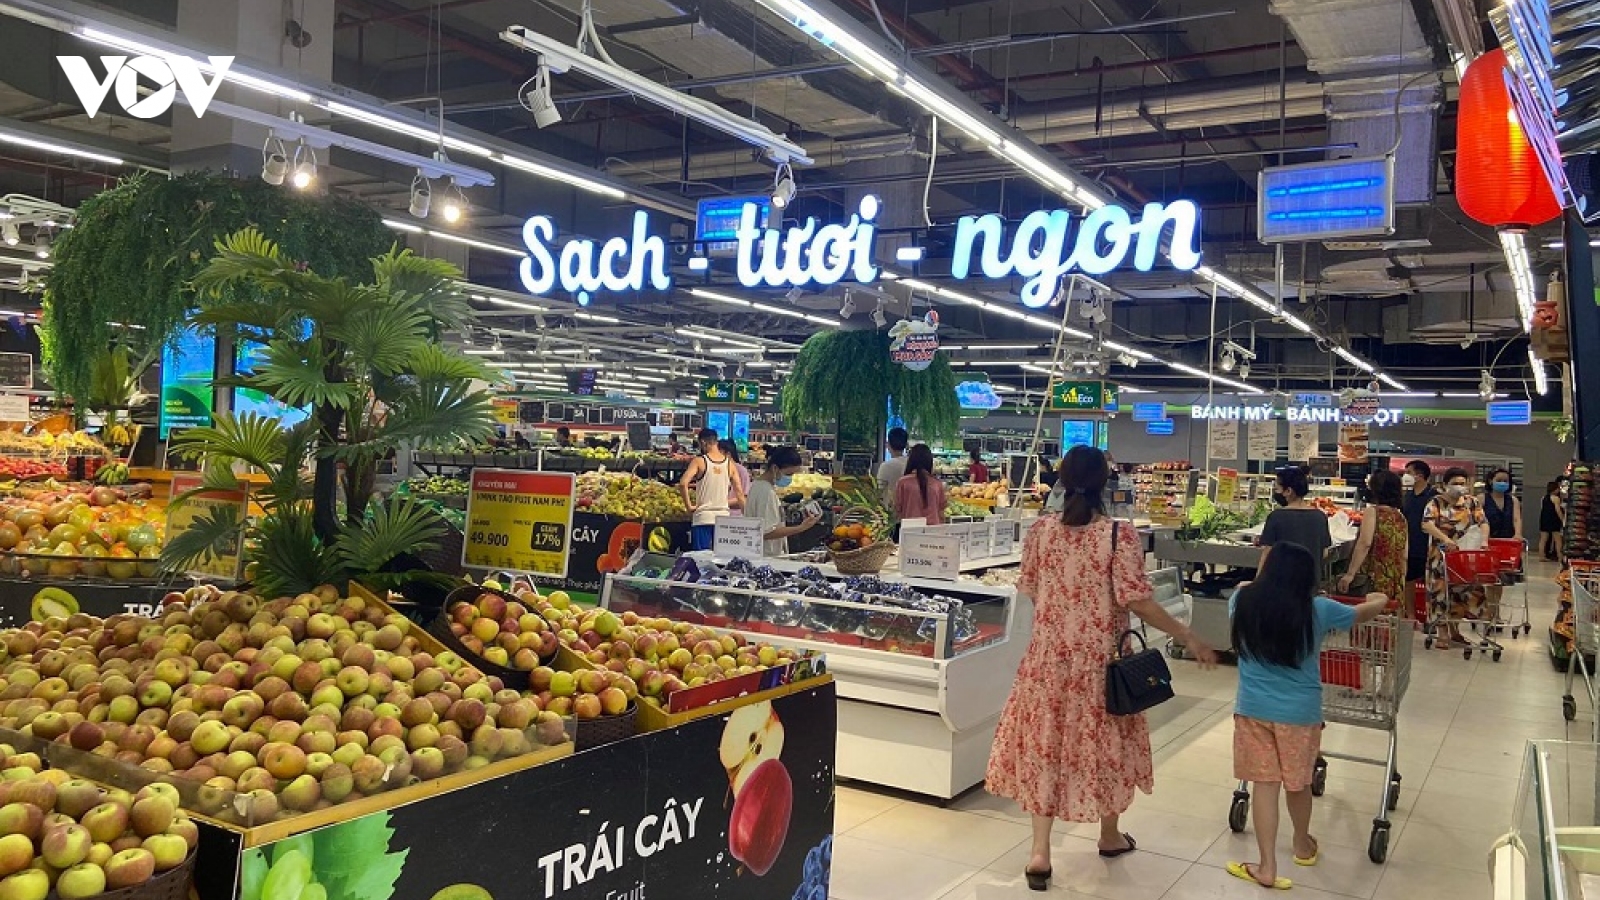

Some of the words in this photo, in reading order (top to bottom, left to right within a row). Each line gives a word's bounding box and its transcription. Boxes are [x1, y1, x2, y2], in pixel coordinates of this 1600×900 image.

[520, 211, 671, 306] Sạch
[735, 195, 881, 287] tươi
[952, 198, 1201, 308] ngon
[1061, 390, 1093, 403] VinEco
[1191, 403, 1240, 419] BÁNH
[1287, 405, 1339, 422] BÁNH
[1404, 415, 1439, 427] Bakery
[470, 531, 508, 547] 49.900
[535, 532, 560, 547] 17%
[572, 525, 599, 543] CÂY
[122, 600, 165, 619] TRÁ
[538, 821, 624, 898] TRÁI
[634, 797, 704, 857] CÂY
